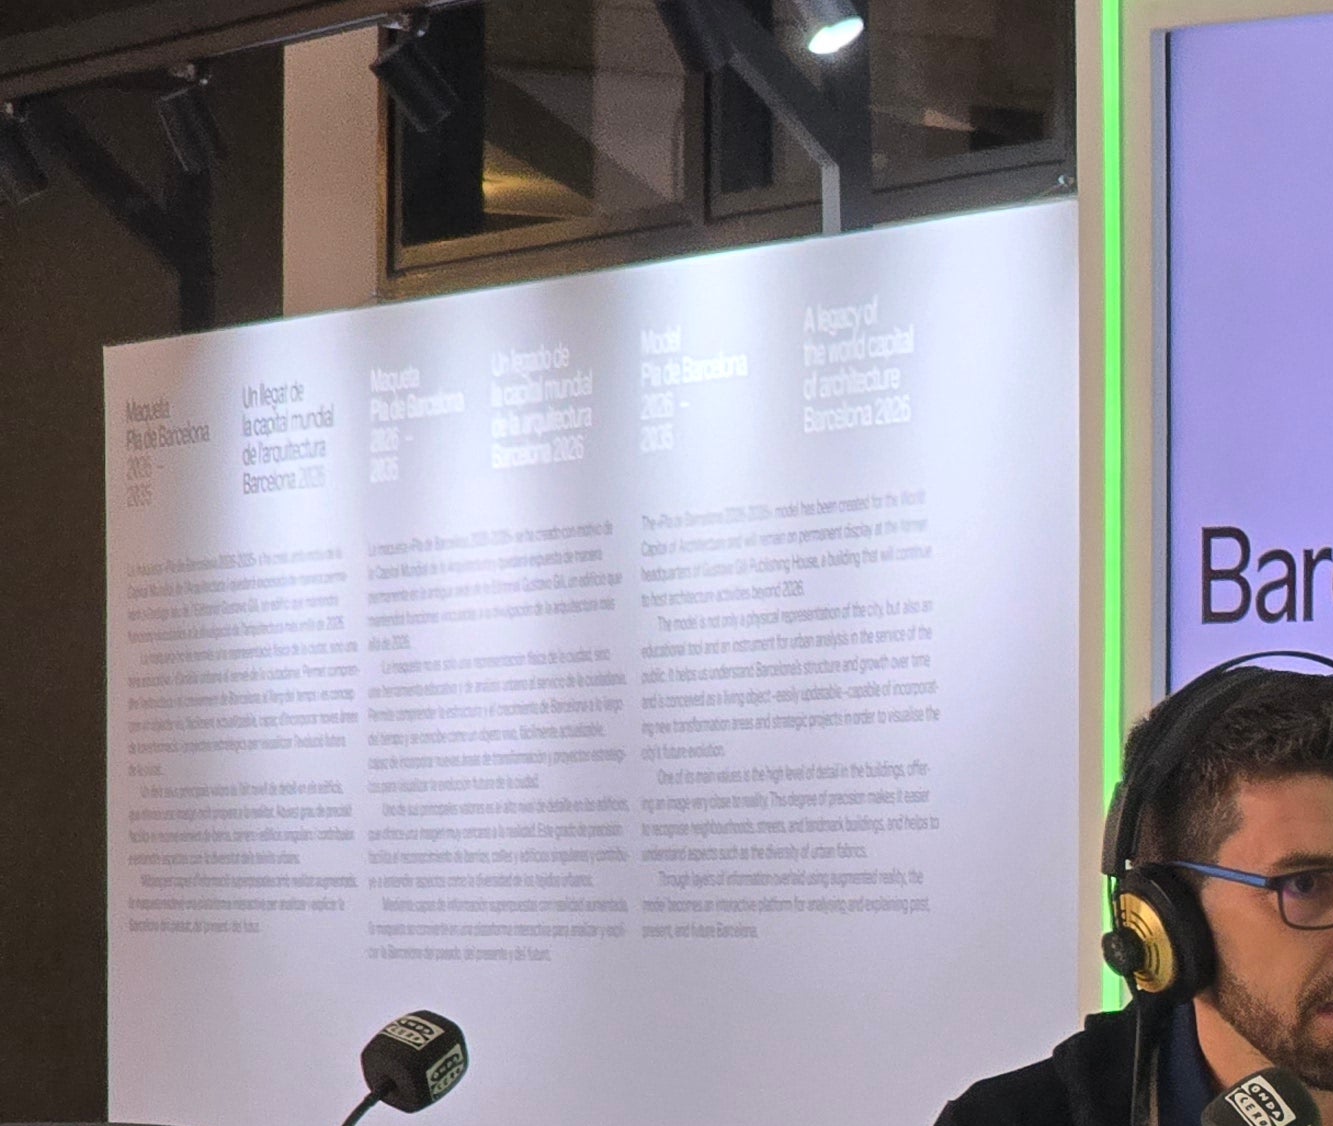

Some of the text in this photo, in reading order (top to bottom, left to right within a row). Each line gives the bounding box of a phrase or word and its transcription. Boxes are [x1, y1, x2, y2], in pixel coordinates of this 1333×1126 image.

[804, 294, 878, 335] A legacy of
[640, 324, 681, 355] Model
[804, 323, 915, 367] the world capital
[491, 342, 570, 378] Un legado de
[640, 351, 748, 388] Pla de Barcelona
[243, 380, 304, 410] Un llegat de
[370, 364, 420, 394] Maqueta
[803, 363, 900, 399] of architecture
[126, 396, 170, 424] Maqueta
[242, 403, 334, 437] la capital mundial
[370, 386, 465, 422] Pla de Barcelona
[804, 394, 911, 434] Barcelona 2026
[126, 421, 211, 451] Pla de Barcelona
[492, 434, 584, 469] Barcelona 2026
[243, 465, 325, 495] Barcelona 2026
[1251, 1085, 1282, 1120] ONDA
